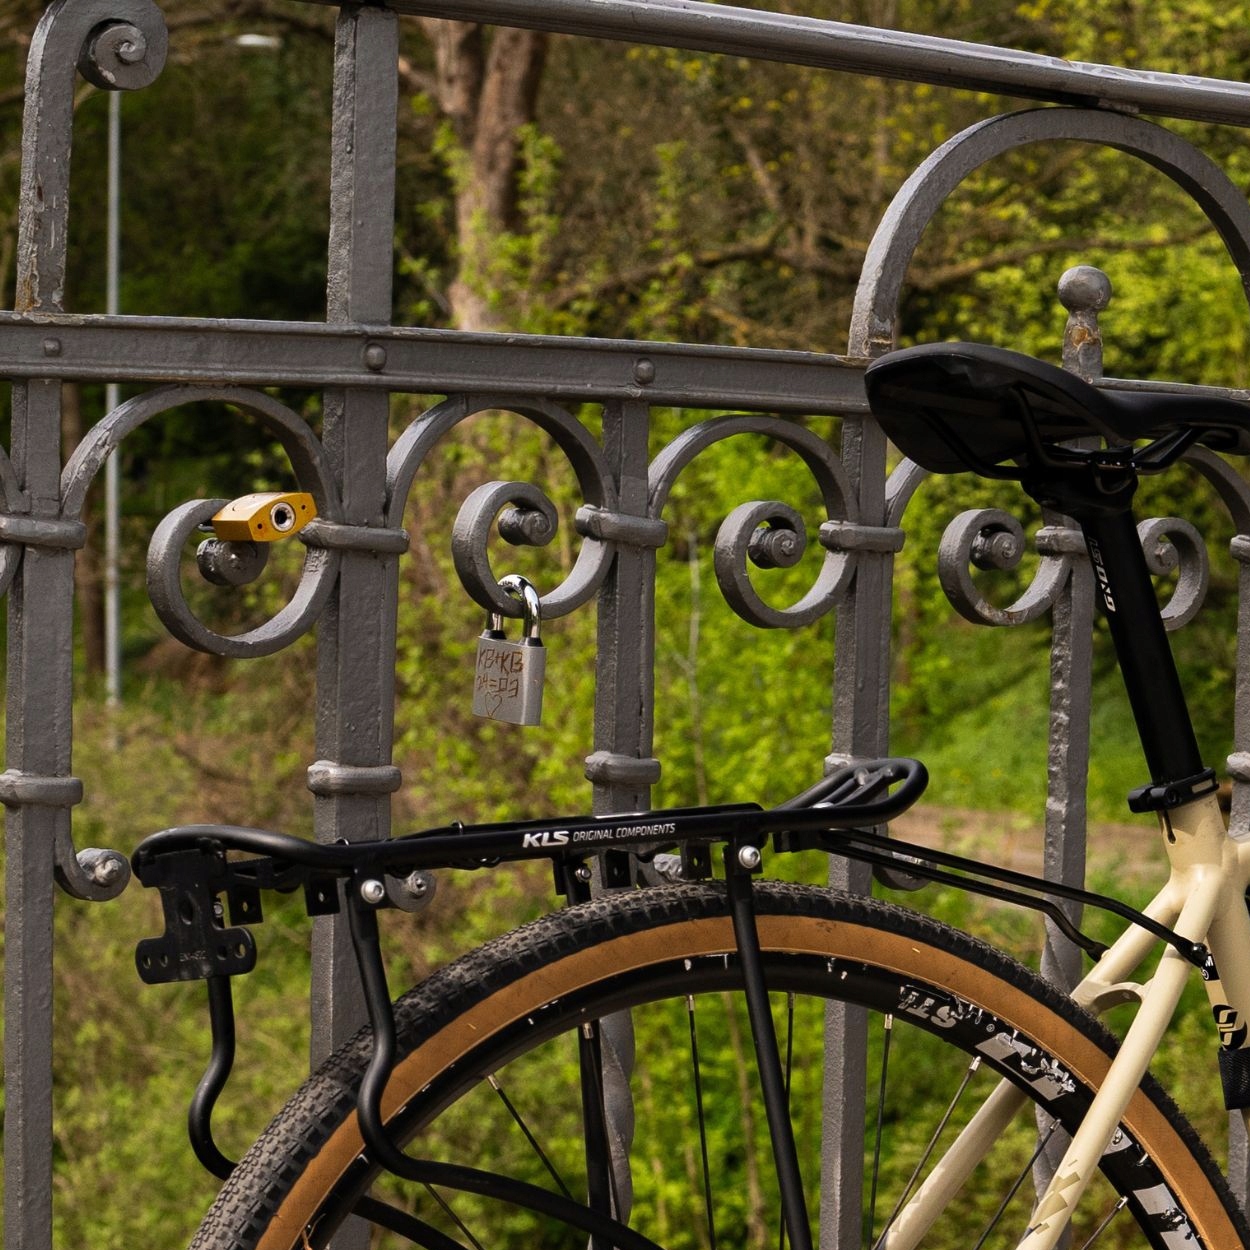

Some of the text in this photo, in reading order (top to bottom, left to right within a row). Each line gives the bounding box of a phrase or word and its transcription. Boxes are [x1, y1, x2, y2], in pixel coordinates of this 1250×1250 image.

[522, 822, 676, 849] KLS ORIGINAL COMPONENTS
